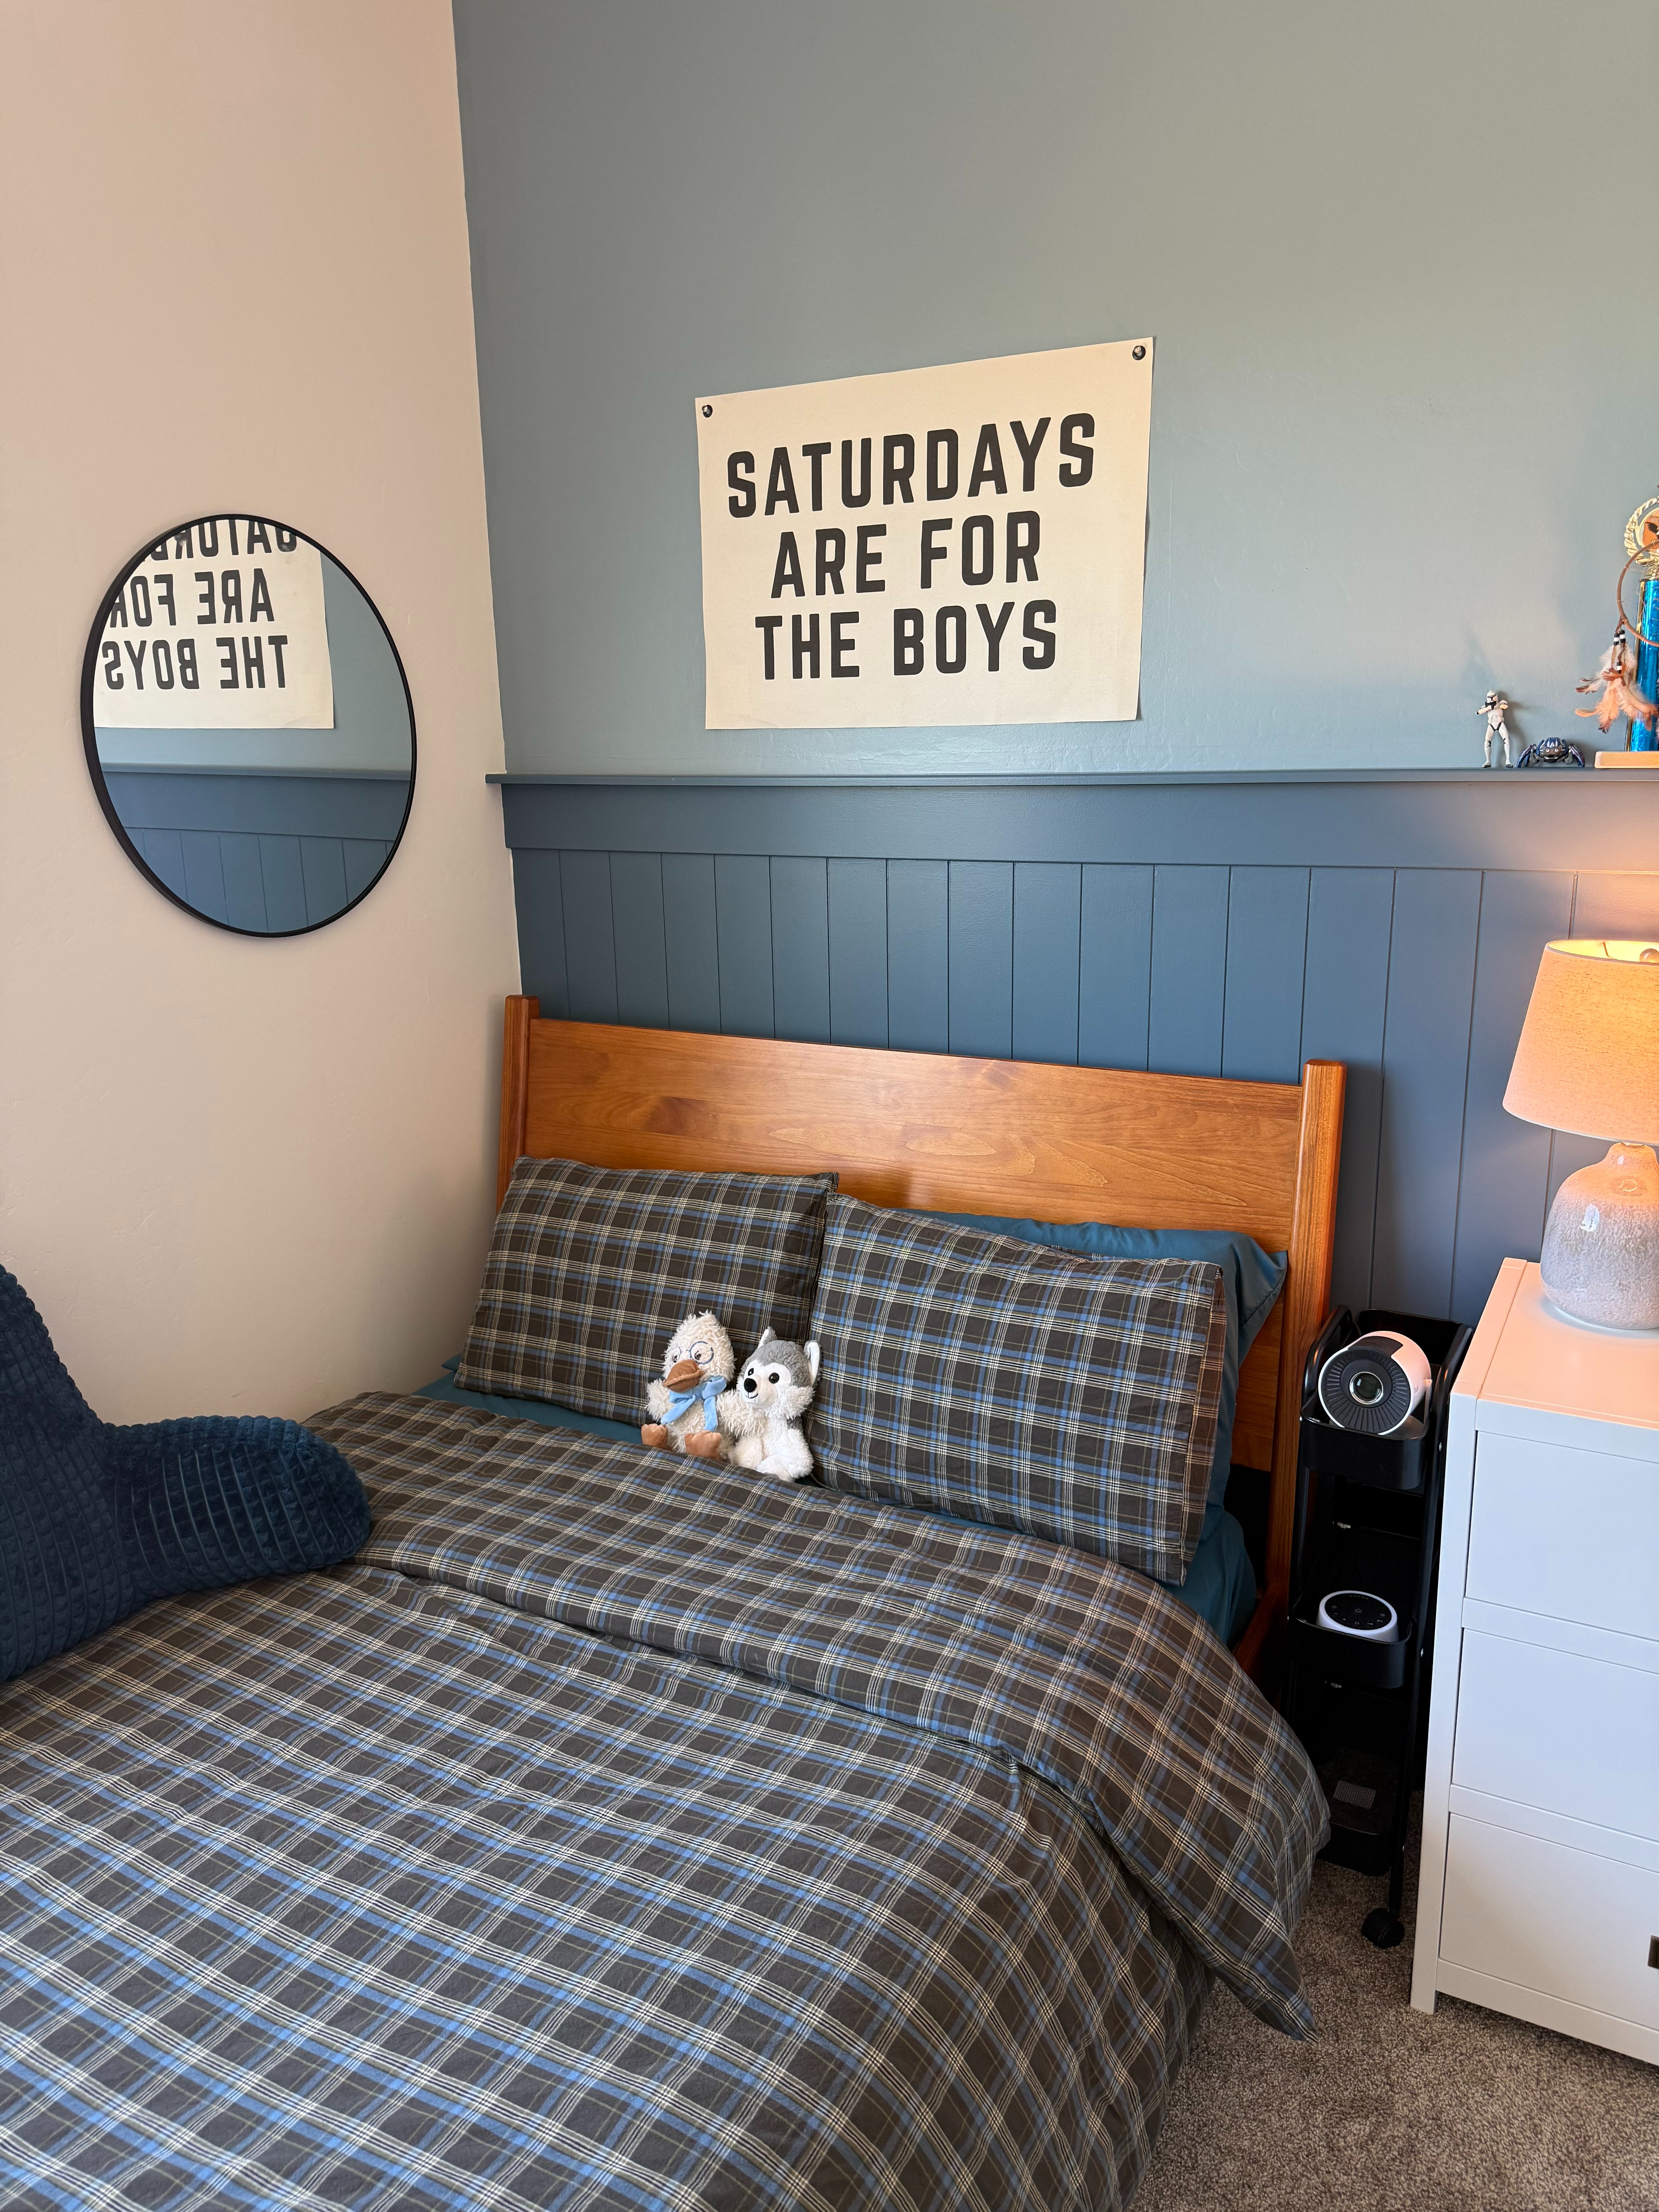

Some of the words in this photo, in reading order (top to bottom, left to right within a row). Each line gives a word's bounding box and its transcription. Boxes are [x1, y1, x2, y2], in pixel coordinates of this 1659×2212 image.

[727, 413, 1095, 518] SATURDAYS
[771, 524, 887, 599] ARE
[921, 510, 1040, 589] FOR
[755, 611, 860, 680] THE
[893, 599, 1056, 676] BOYS
